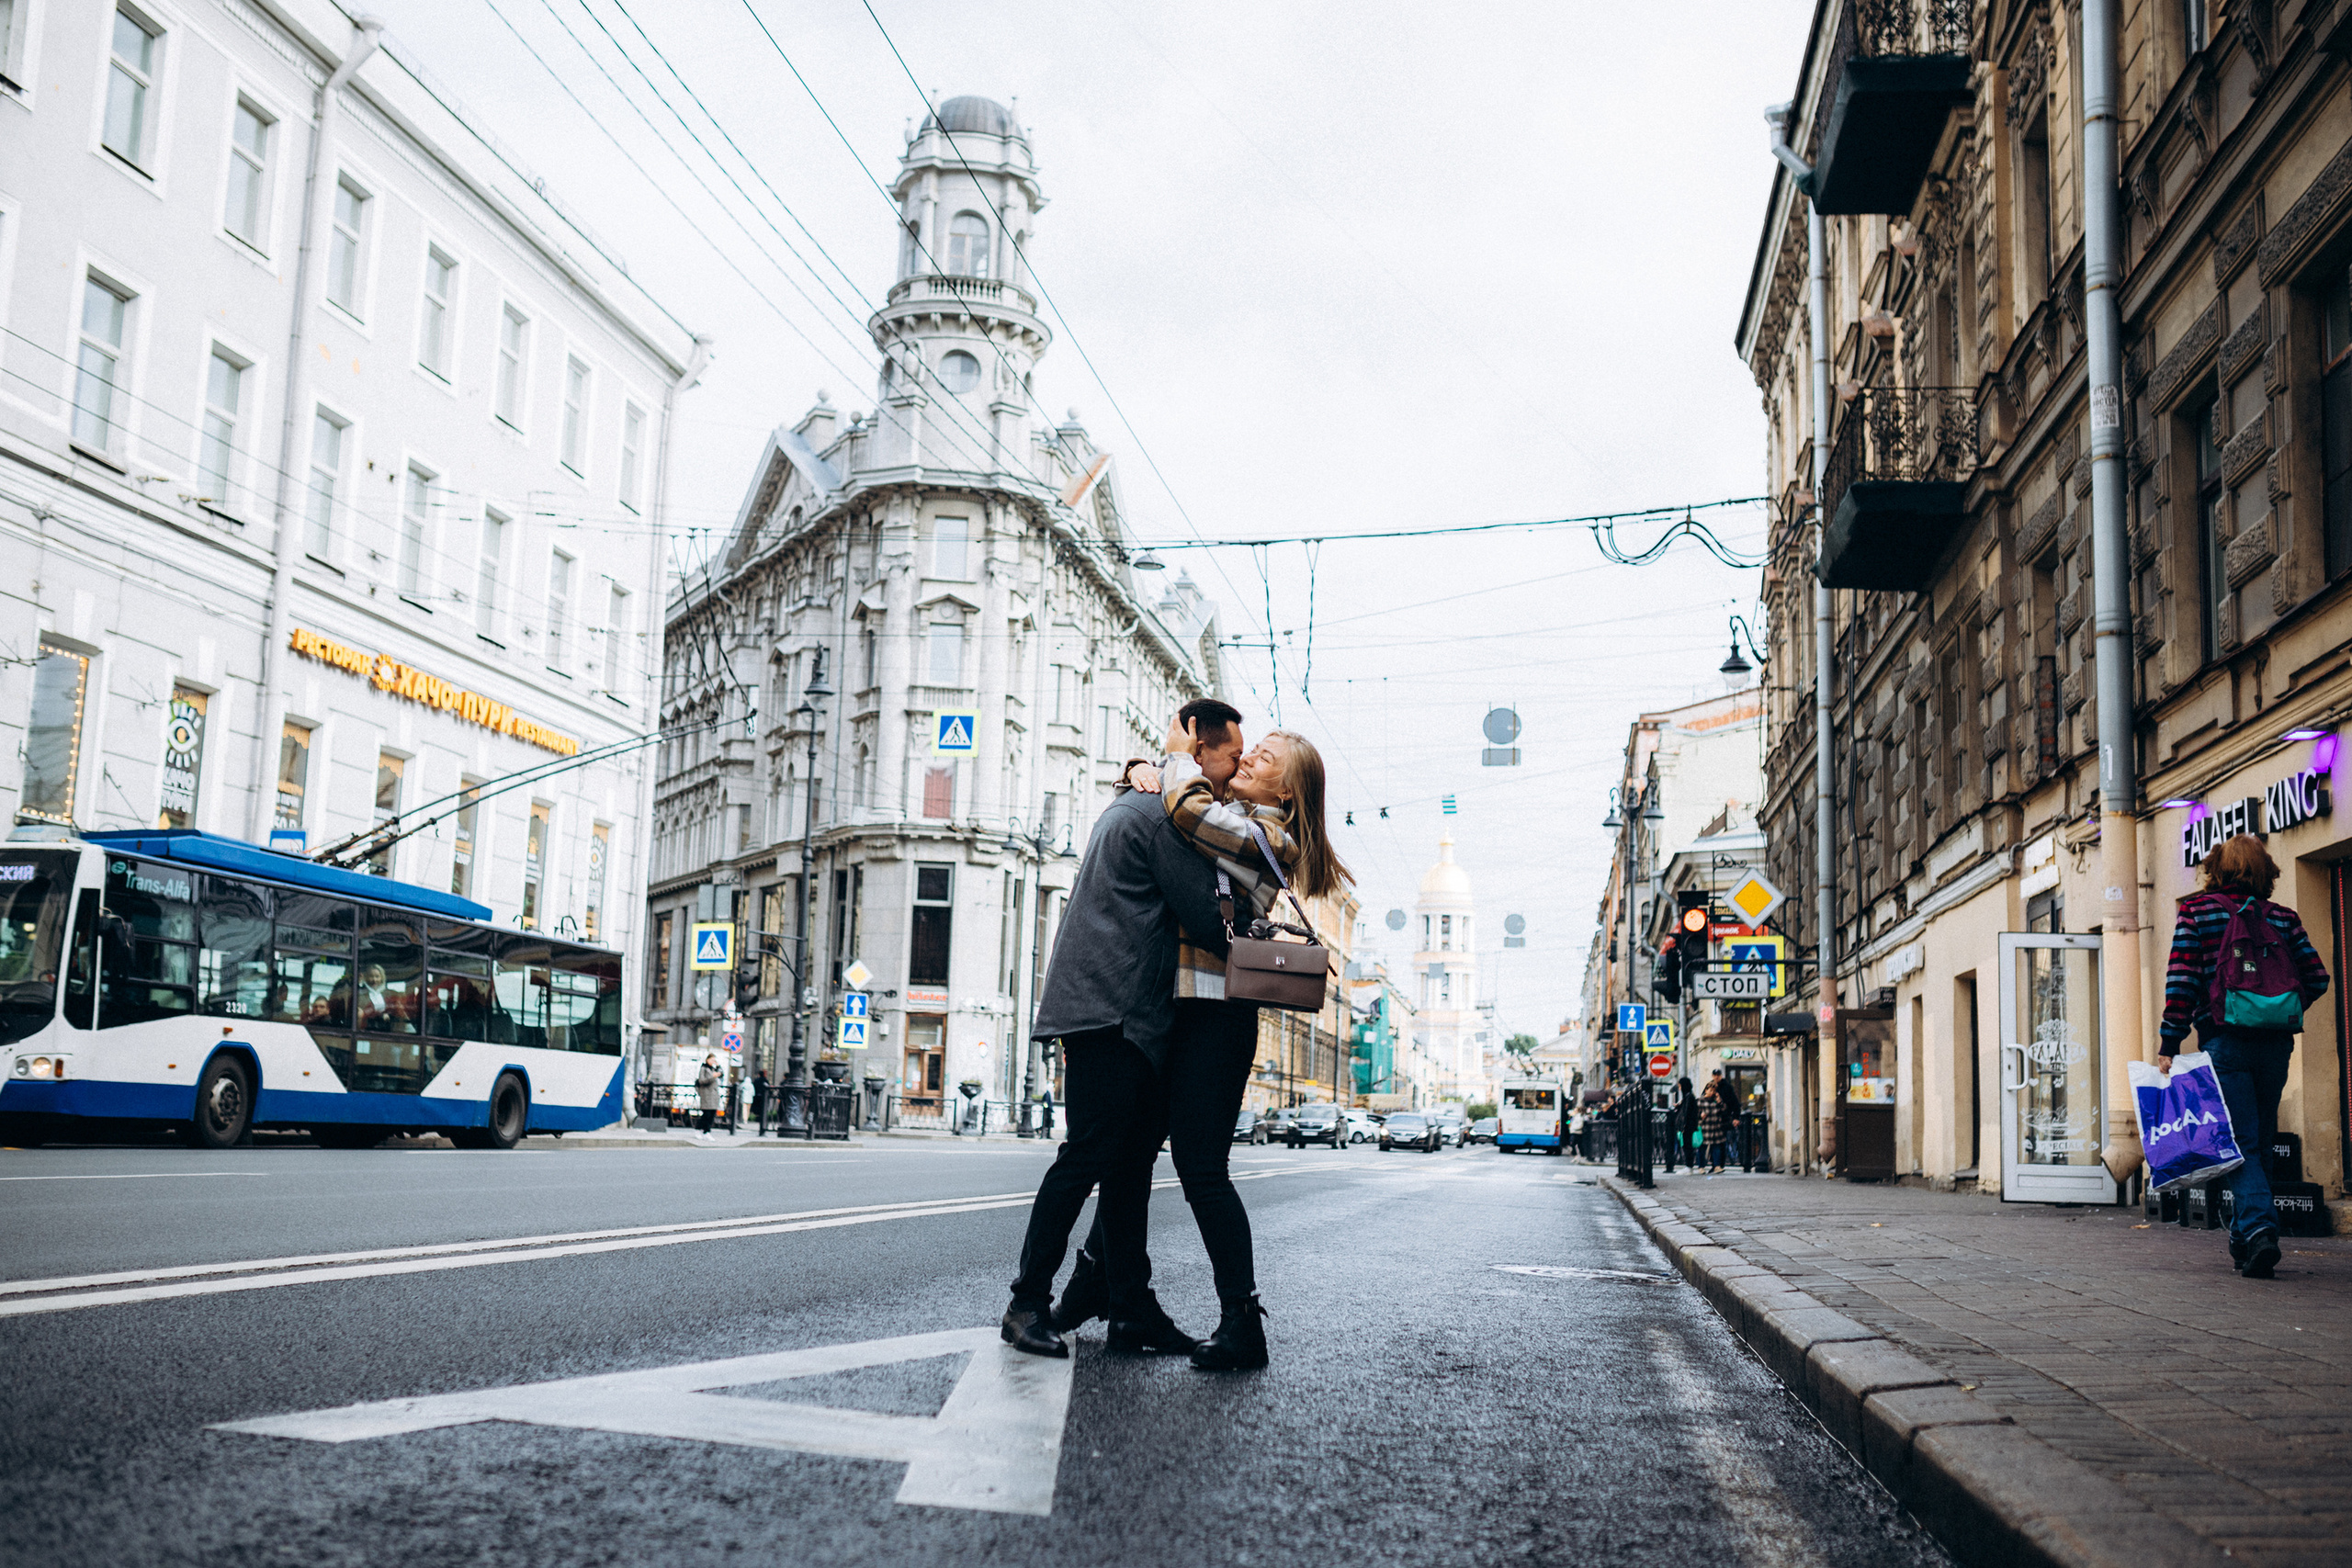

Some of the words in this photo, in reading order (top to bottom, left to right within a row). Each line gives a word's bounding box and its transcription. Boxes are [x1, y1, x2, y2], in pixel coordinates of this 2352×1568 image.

[294, 628, 372, 677] РЕСТОРАН
[395, 663, 455, 712] ХАЧО
[462, 690, 514, 735] ПУРИ
[514, 717, 580, 756] RESTAURANT
[2182, 796, 2256, 868] FALAFEL
[2266, 767, 2320, 834] KING
[126, 869, 191, 901] Trans-Alfa
[1705, 977, 1758, 994] СТОП
[225, 1000, 247, 1014] 2320
[1733, 1048, 1757, 1059] DAILY
[2273, 1198, 2313, 1213] fritz-kola
